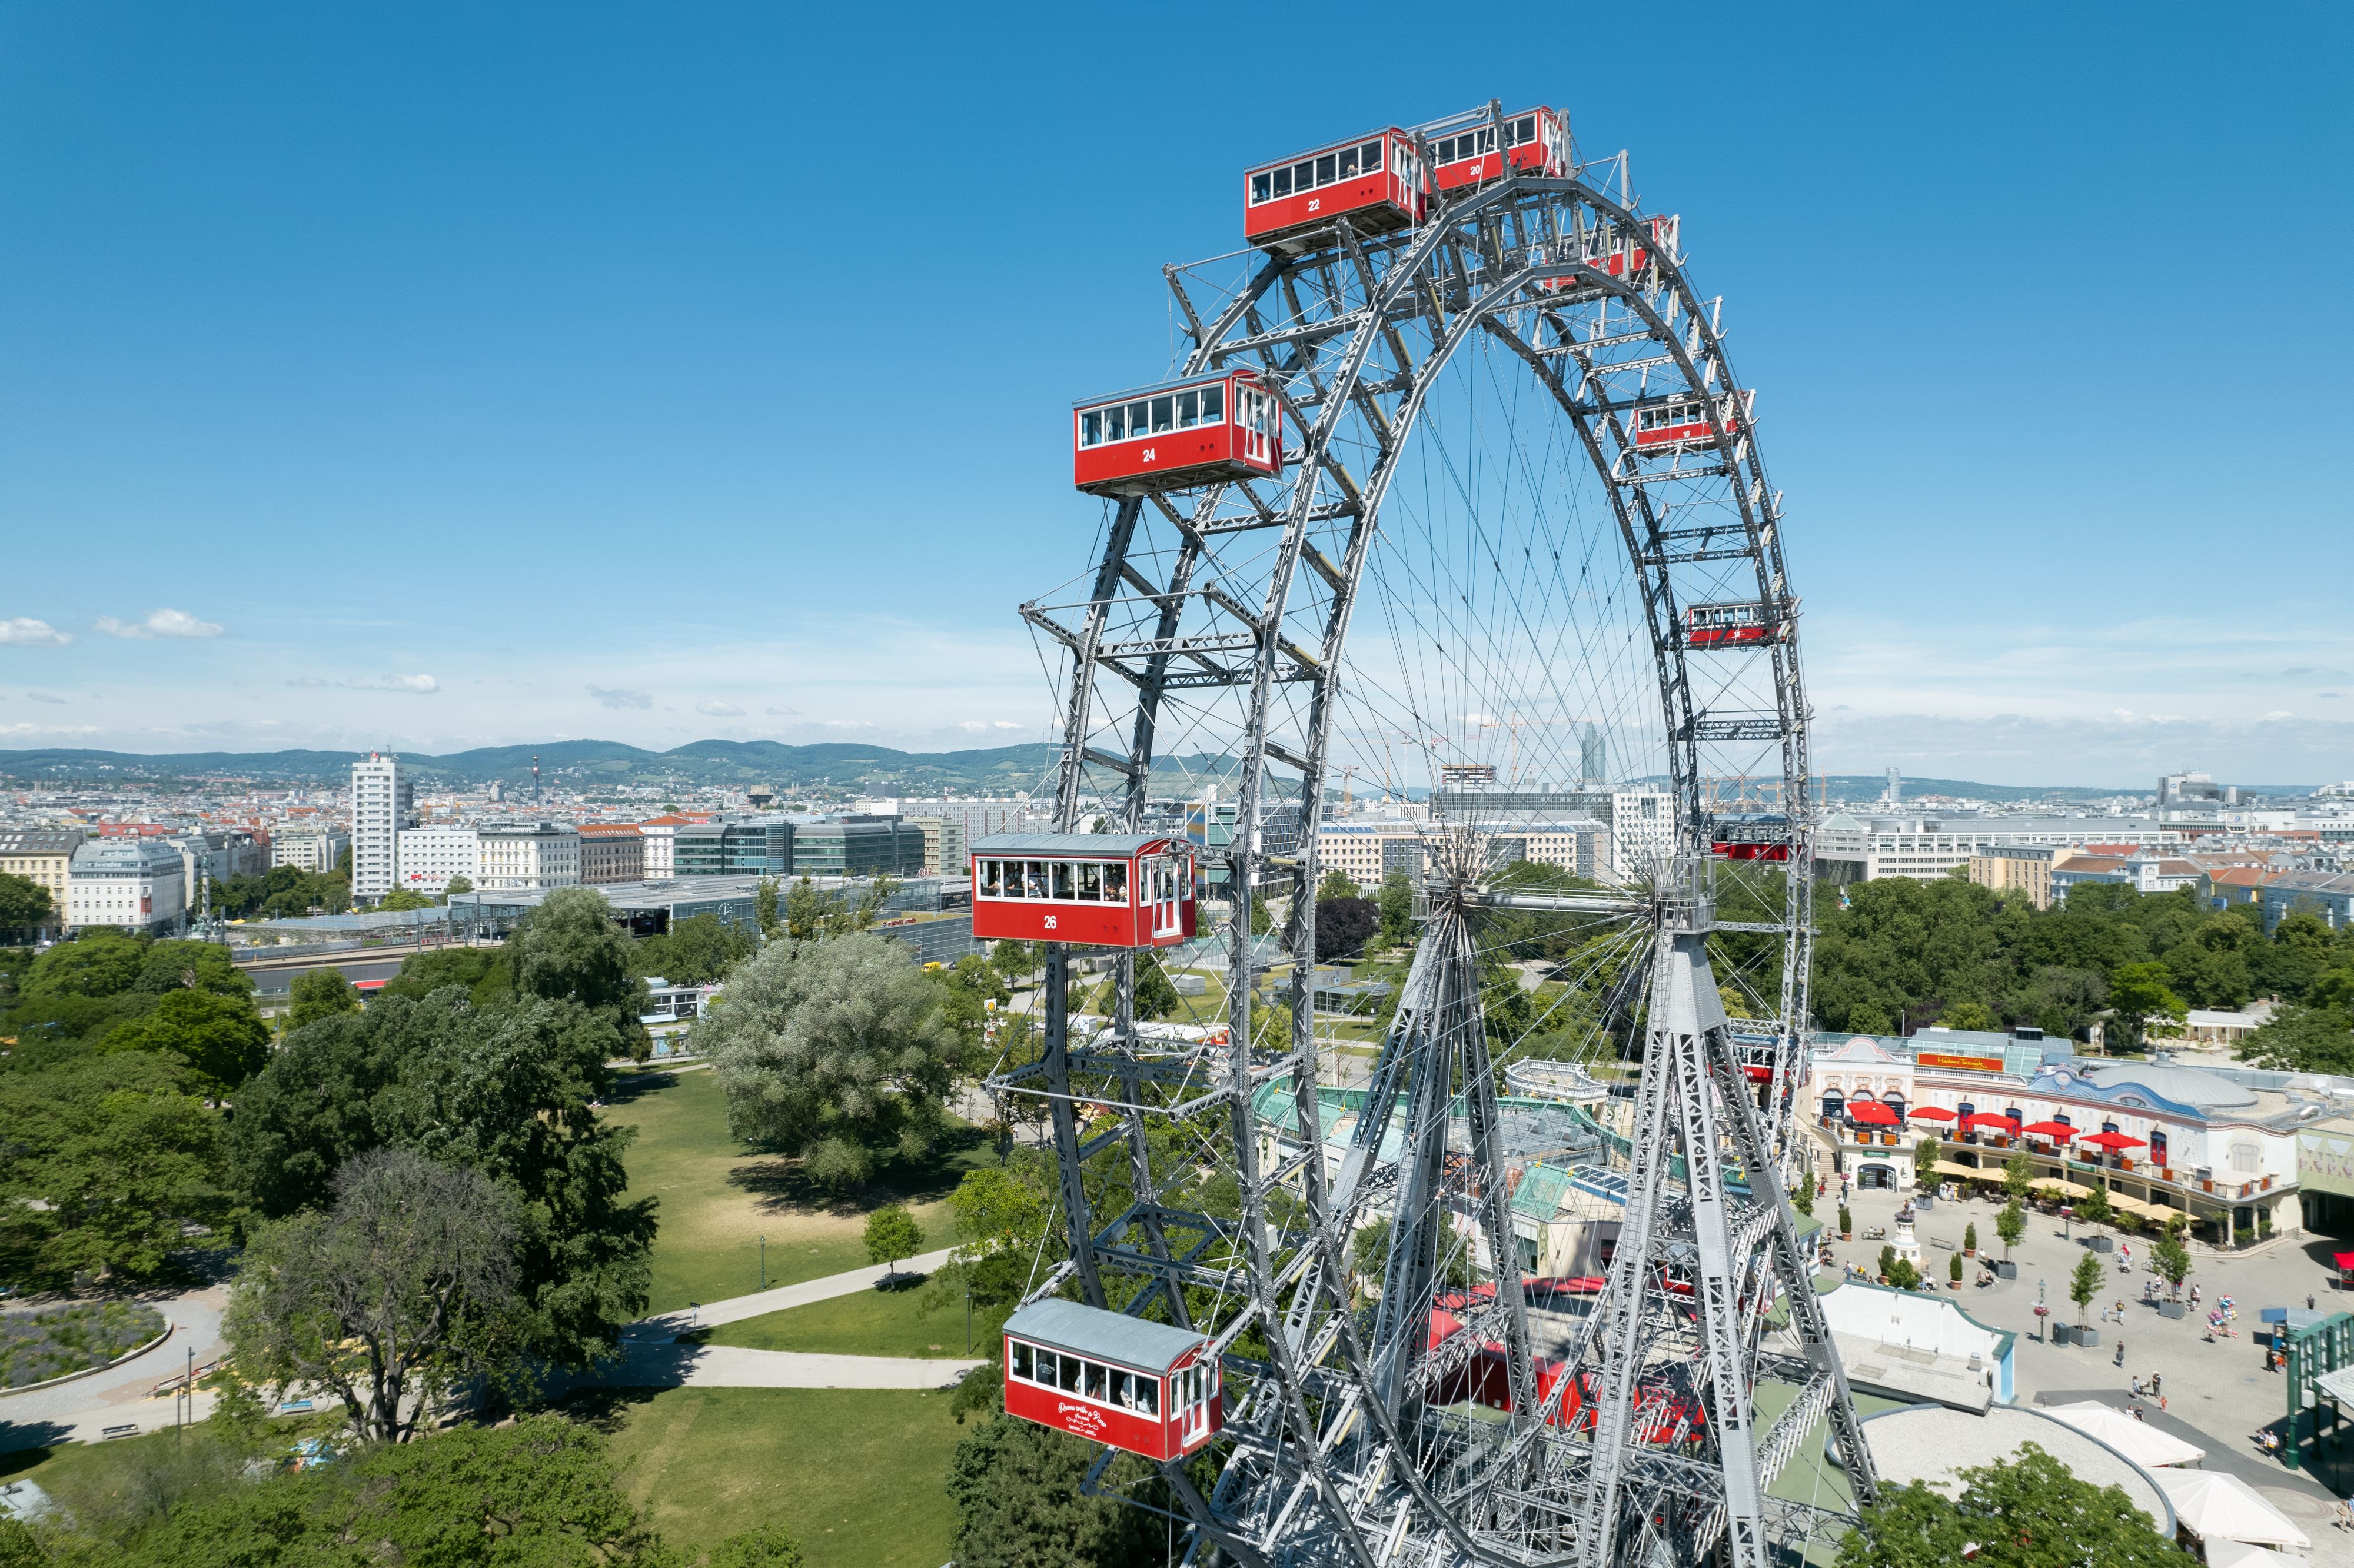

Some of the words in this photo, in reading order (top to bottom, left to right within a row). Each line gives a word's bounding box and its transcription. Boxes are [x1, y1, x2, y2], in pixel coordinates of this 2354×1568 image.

[1470, 165, 1481, 176] 20
[1308, 199, 1320, 212] 22
[1683, 430, 1690, 438] 16
[1143, 448, 1156, 462] 24
[1044, 915, 1057, 930] 26
[1937, 1056, 1960, 1064] Madame
[1959, 1058, 1984, 1069] Tussauds
[1058, 1402, 1076, 1413] Room
[1093, 1410, 1107, 1427] View
